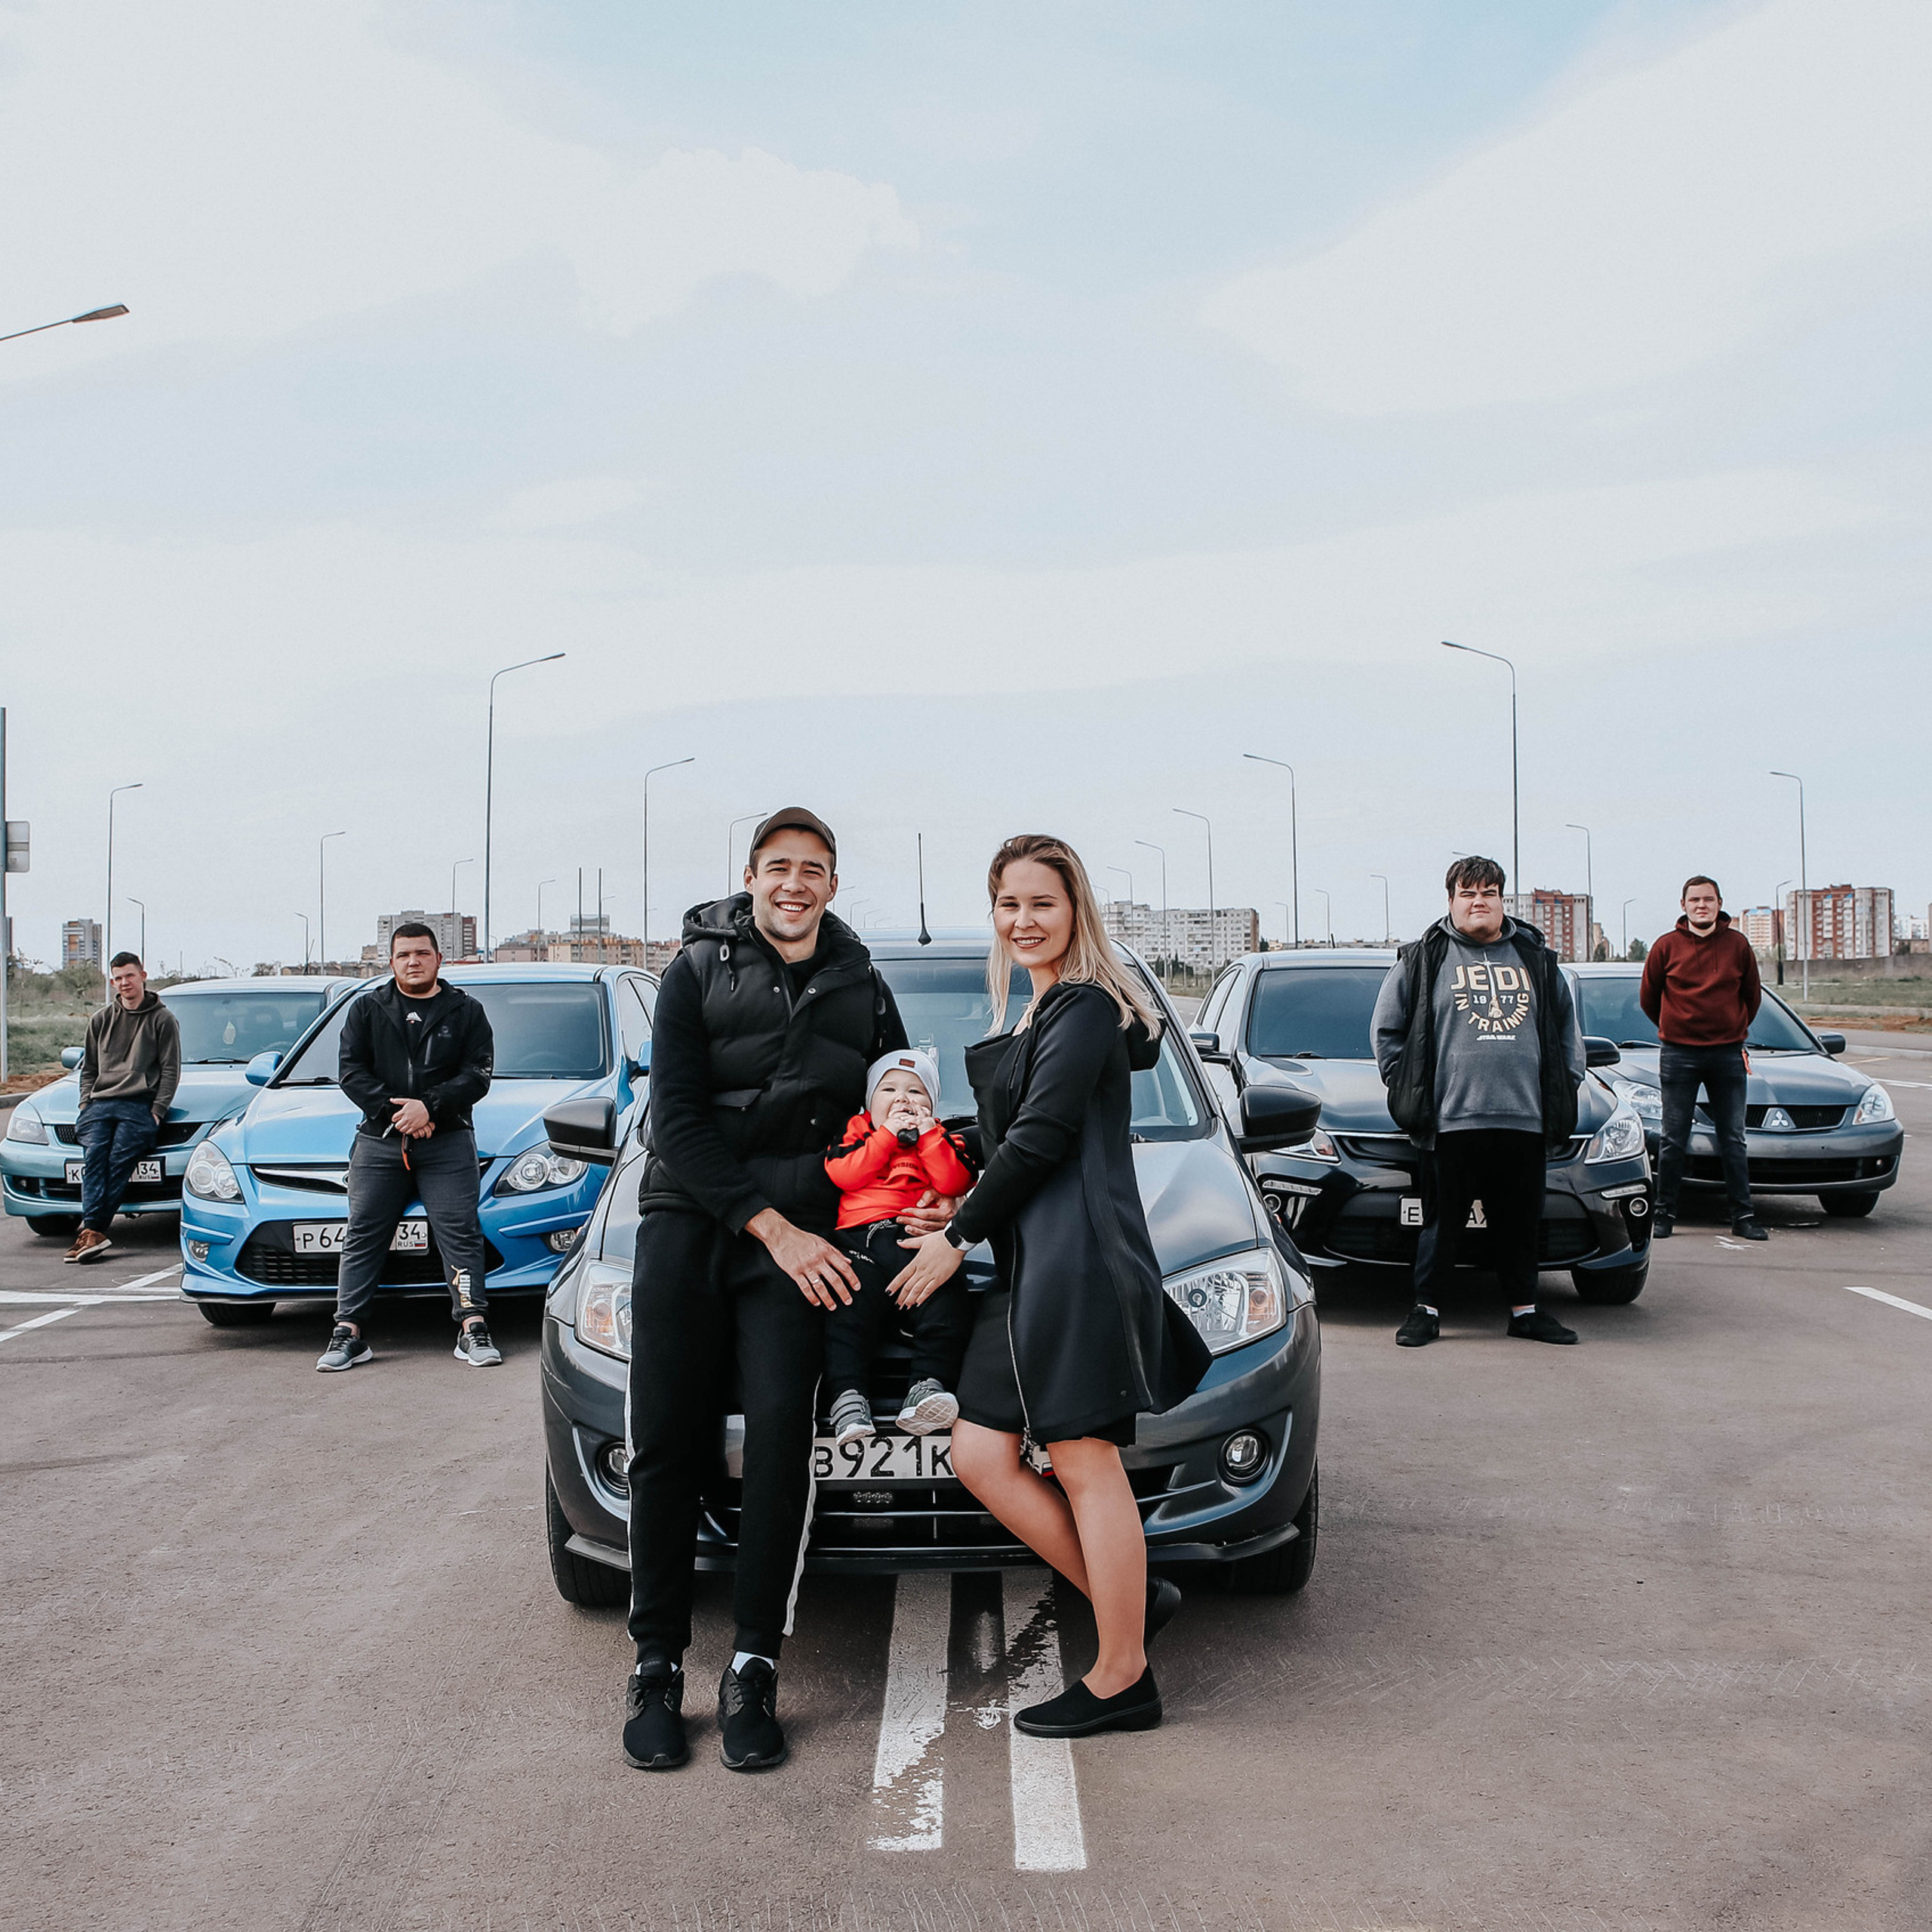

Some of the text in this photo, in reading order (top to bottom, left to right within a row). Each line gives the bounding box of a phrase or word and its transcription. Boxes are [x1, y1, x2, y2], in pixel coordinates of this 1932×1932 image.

[1451, 965, 1531, 991] JEDI
[1454, 993, 1529, 1032] IN TRAINING
[1500, 995, 1514, 1004] 77
[814, 1436, 955, 1478] B921K
